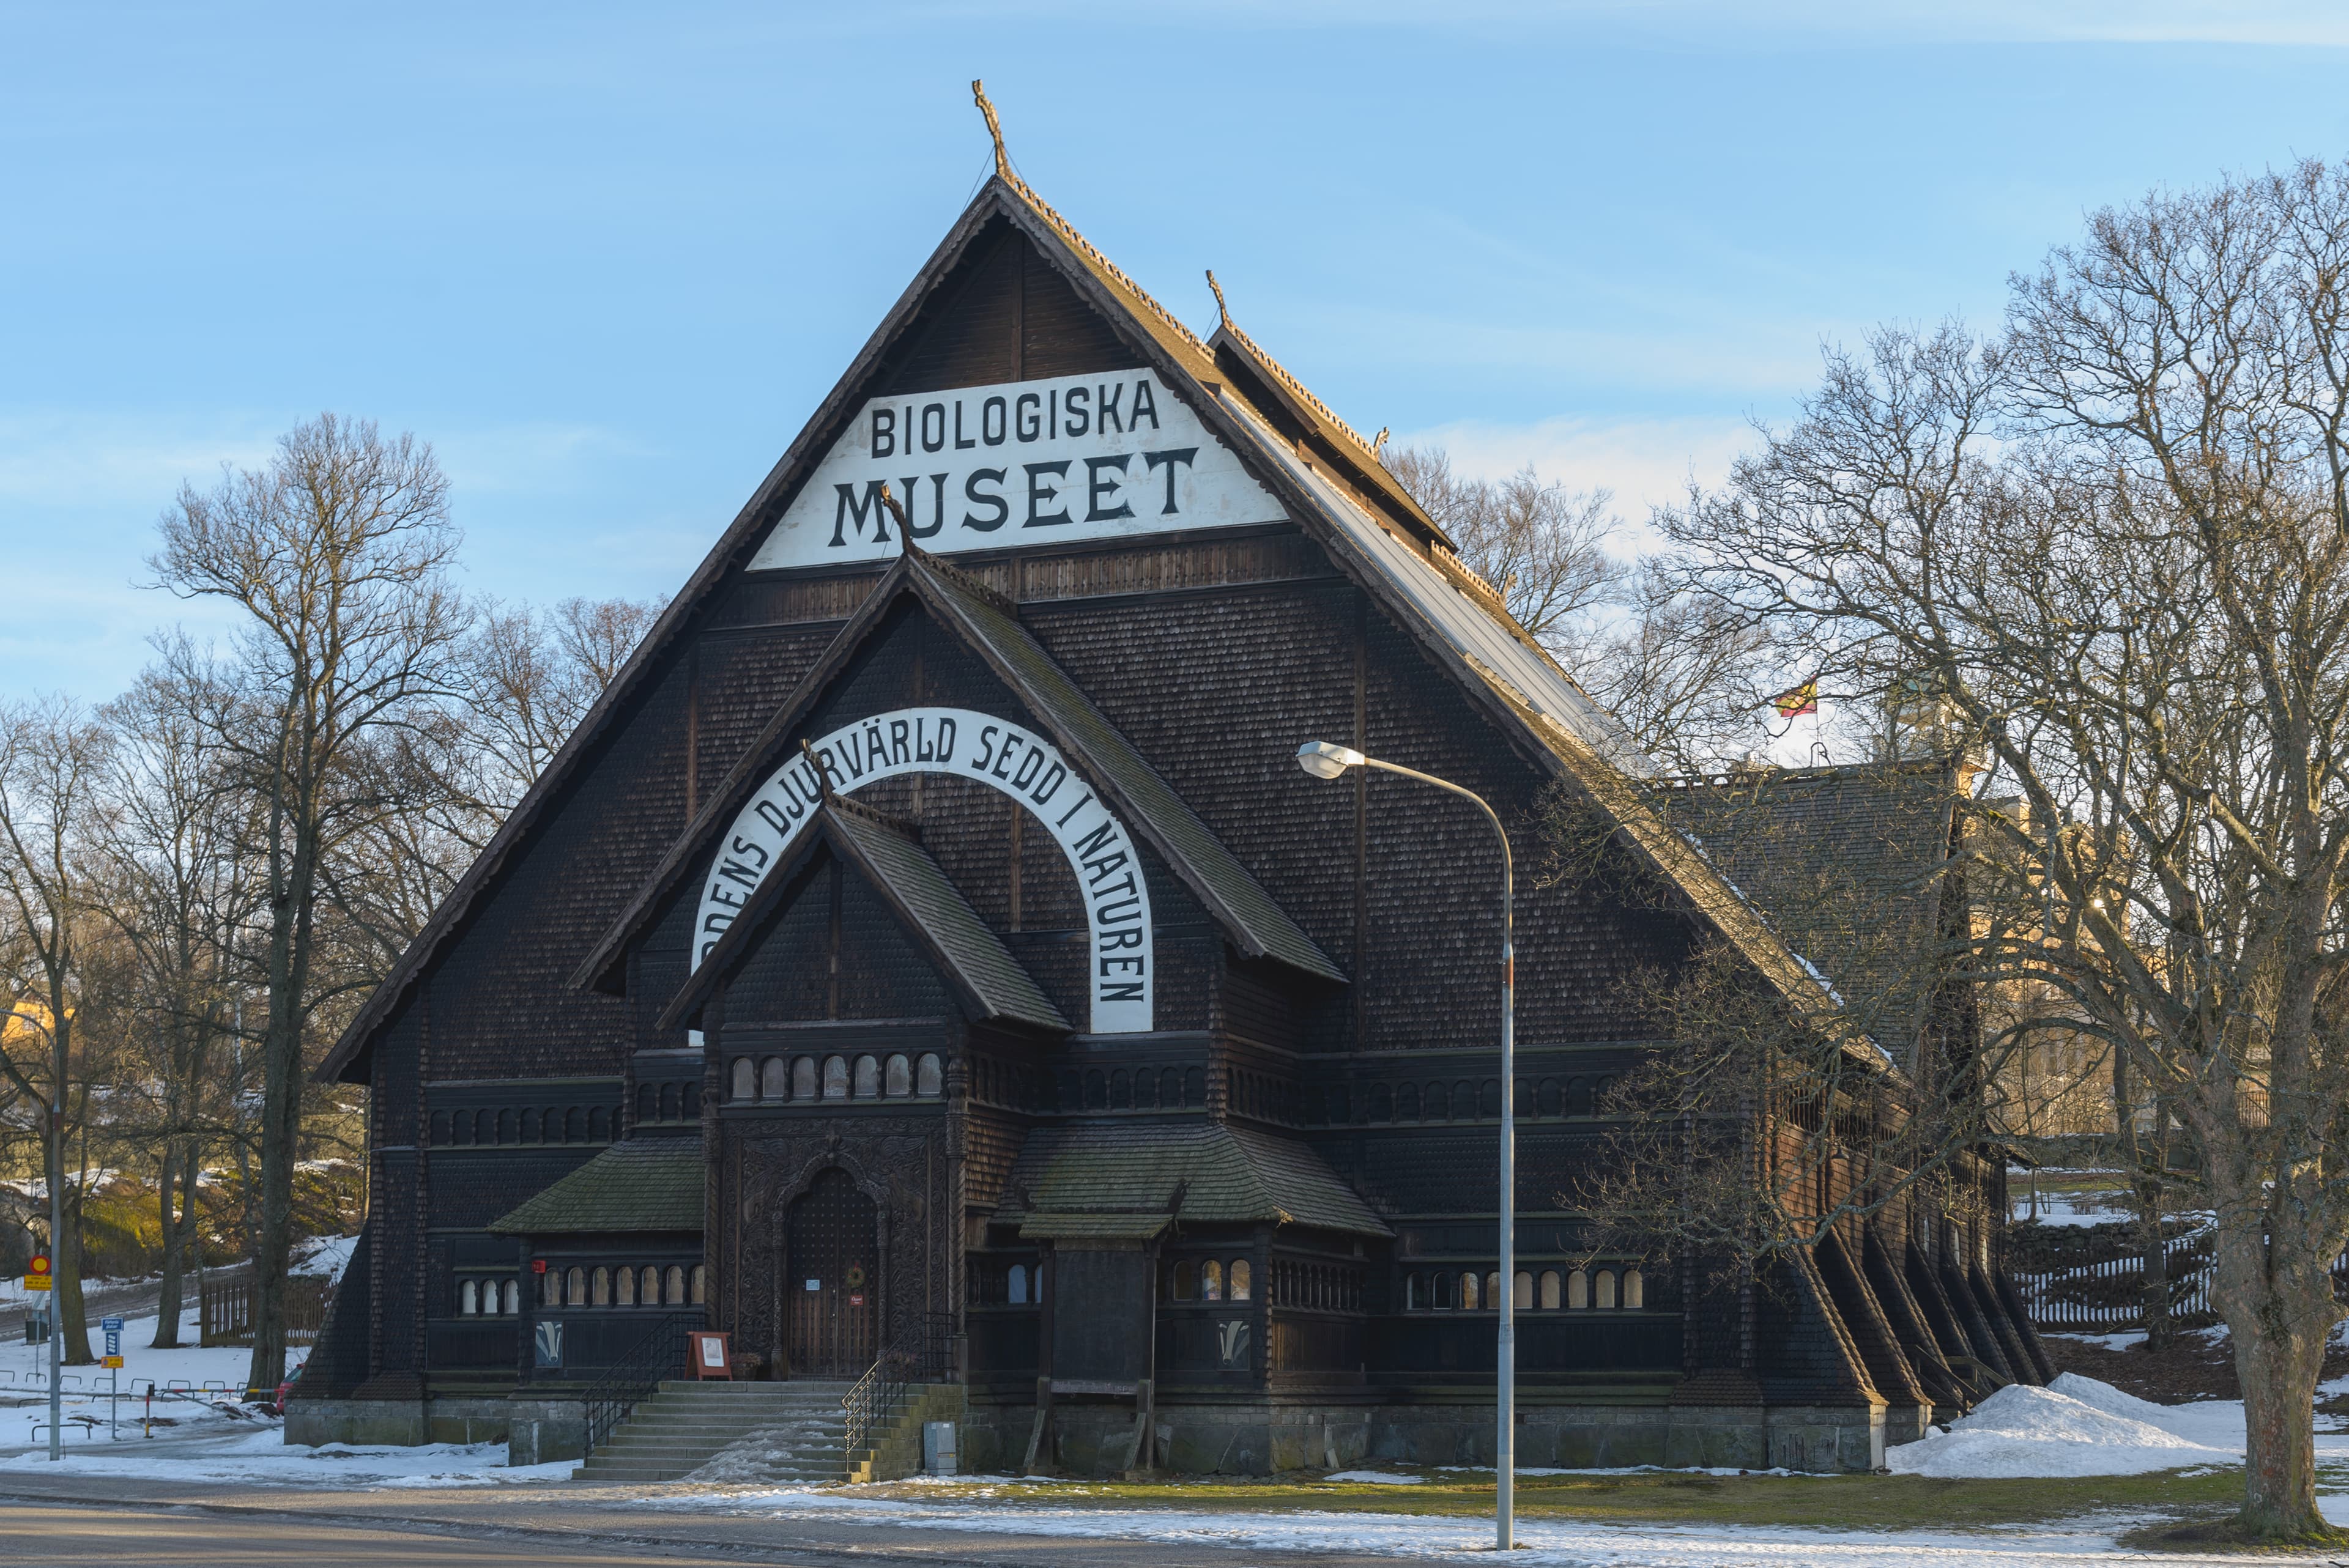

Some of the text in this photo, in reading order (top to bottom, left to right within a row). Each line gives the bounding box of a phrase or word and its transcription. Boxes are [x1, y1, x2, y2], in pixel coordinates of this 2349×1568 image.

[872, 380, 1159, 459] BIOLOGISKA
[828, 447, 1199, 546] MUSEET
[700, 718, 1144, 1002] DENS DJURVÄRLD SEDD I NATUREN
